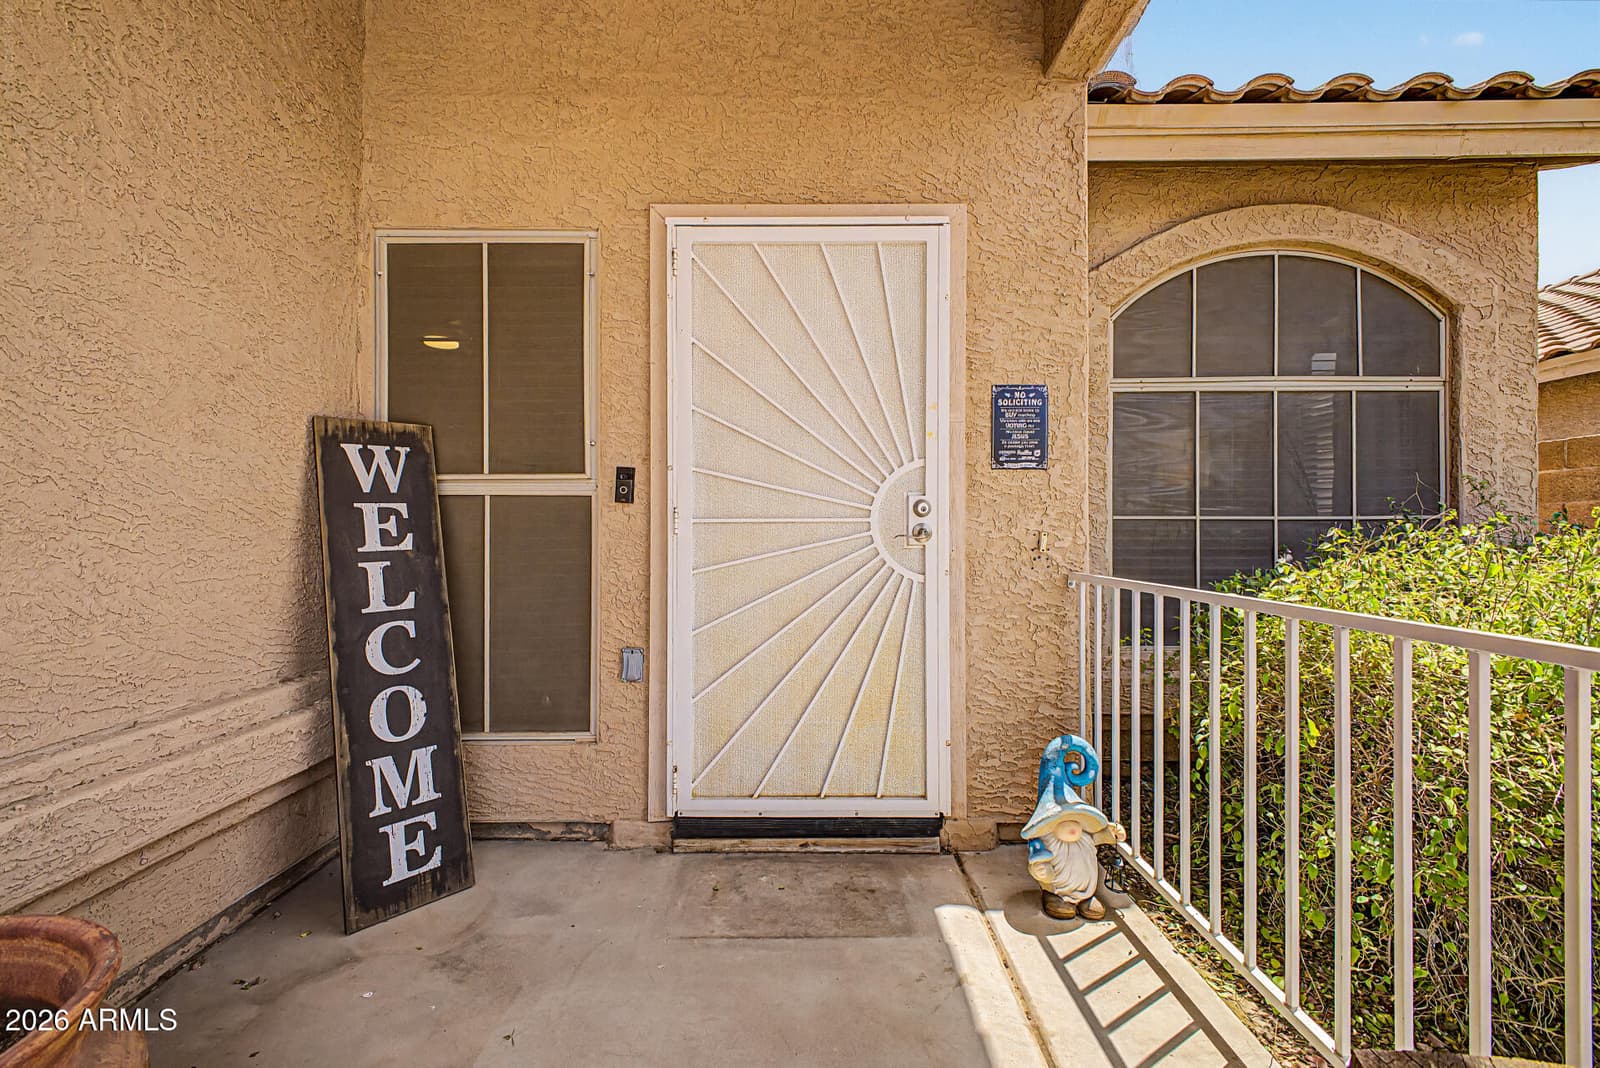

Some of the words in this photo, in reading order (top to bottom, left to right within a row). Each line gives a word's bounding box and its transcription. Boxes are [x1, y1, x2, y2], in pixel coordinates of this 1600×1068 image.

[1014, 391, 1026, 399] NO
[997, 398, 1043, 406] SOLICITING
[340, 443, 442, 887] WELCOME
